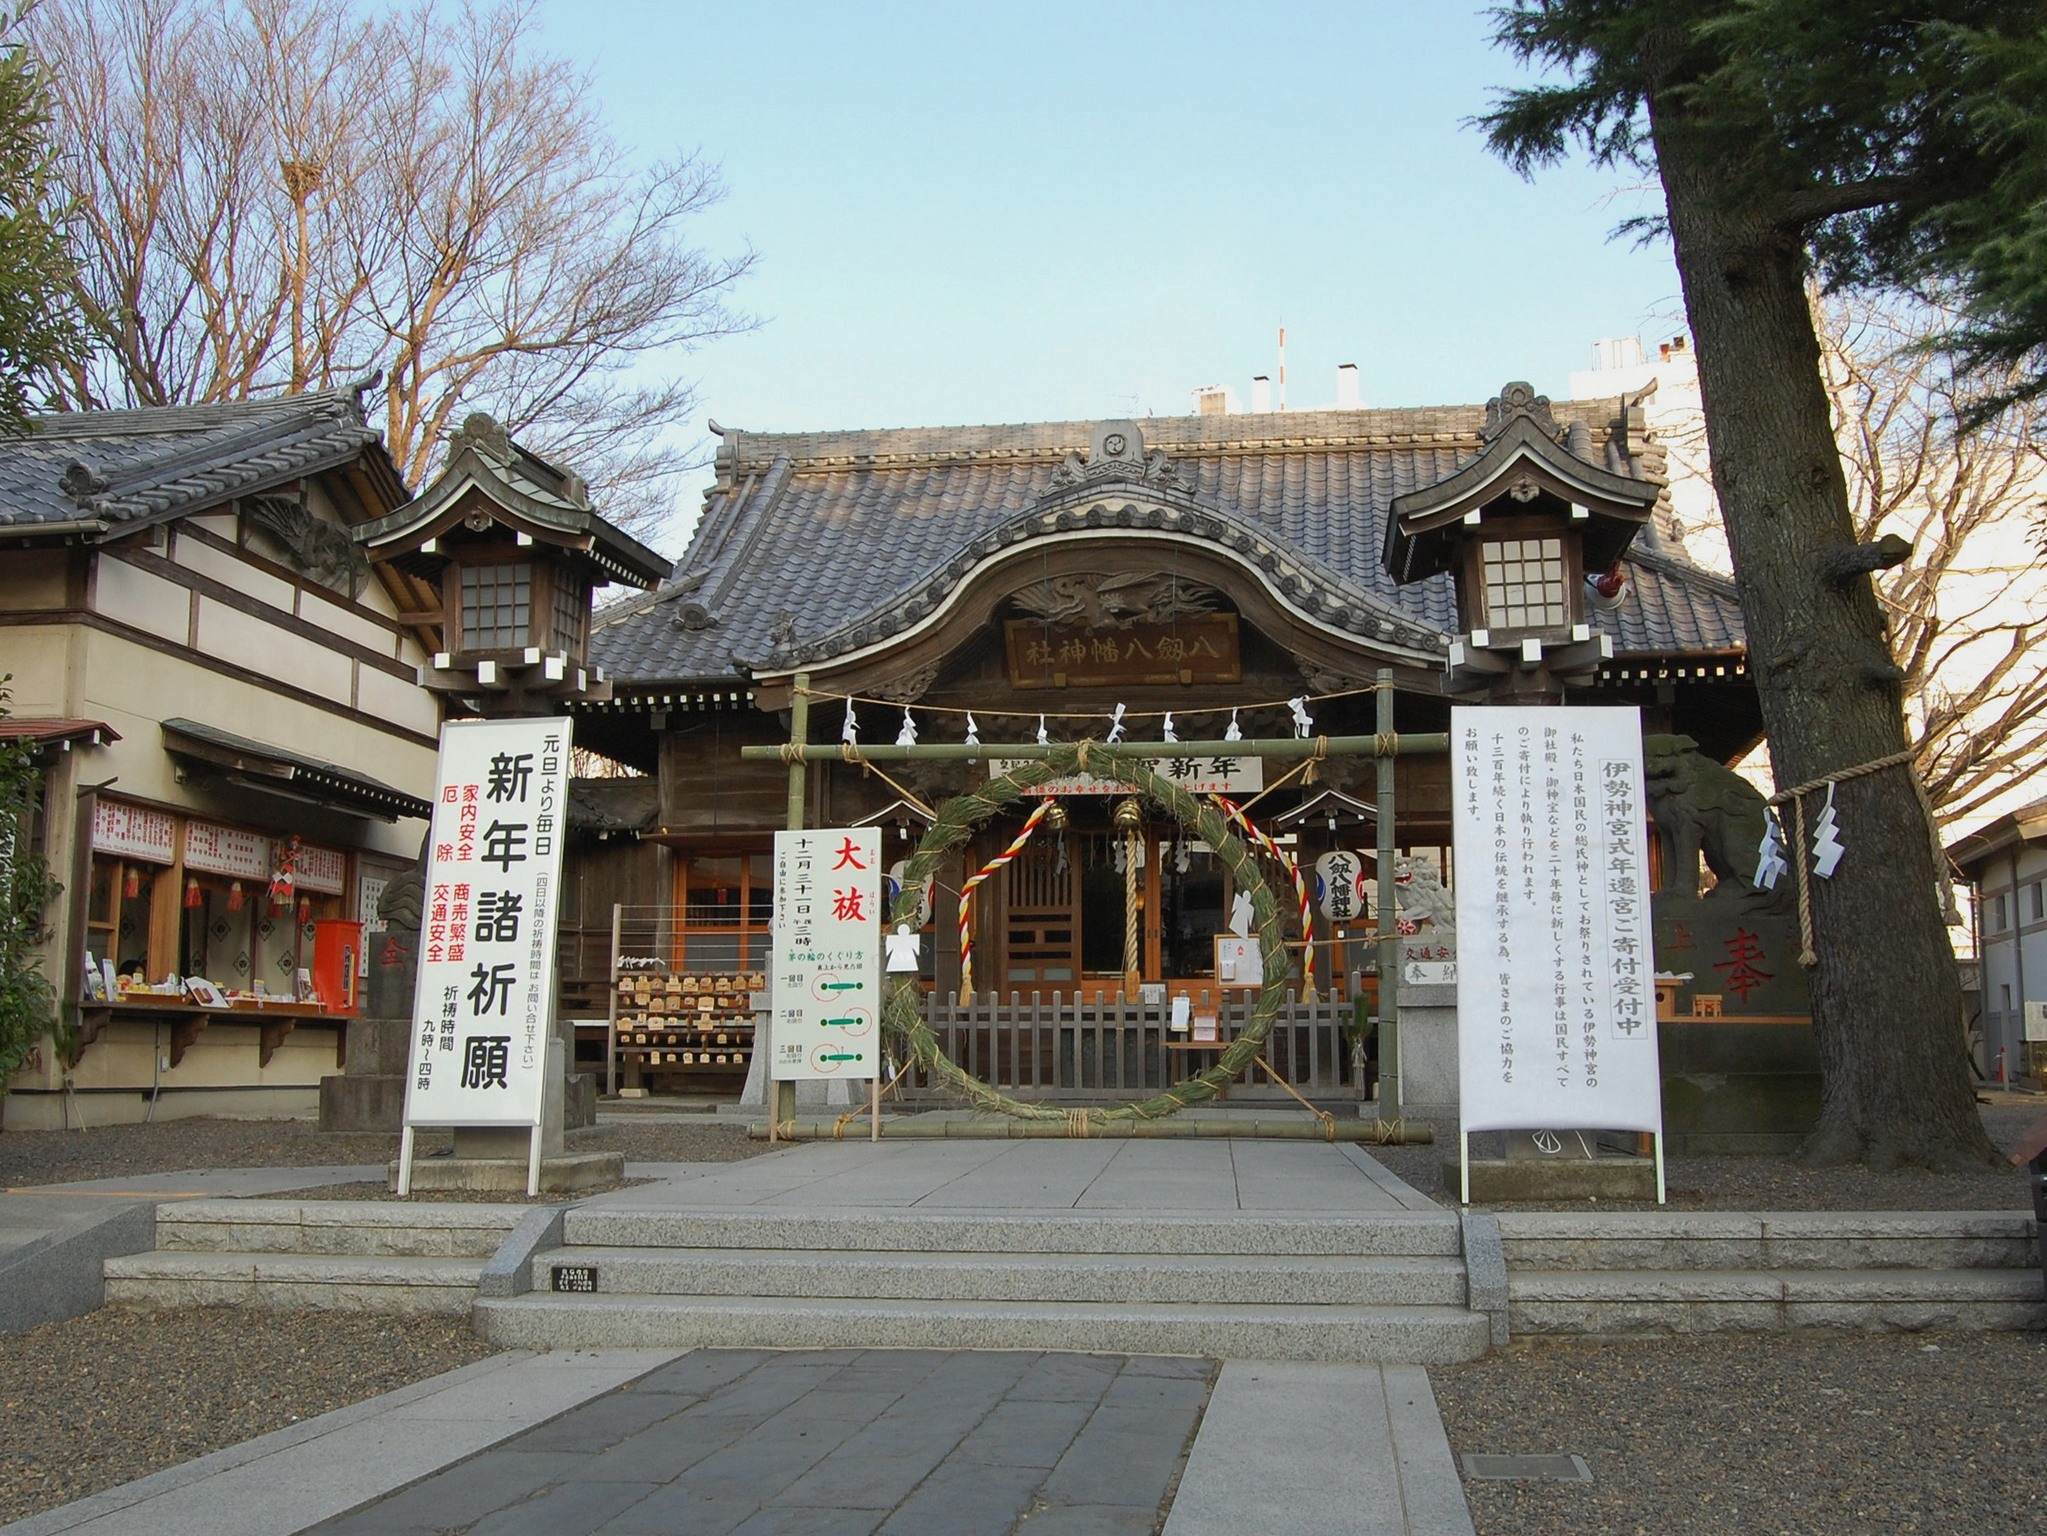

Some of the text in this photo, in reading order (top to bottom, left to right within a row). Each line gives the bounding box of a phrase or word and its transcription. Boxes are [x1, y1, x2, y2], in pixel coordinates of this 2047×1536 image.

[436, 785, 459, 862] 厄除
[457, 784, 479, 861] 家内安全
[535, 734, 560, 856] 元旦より毎日
[831, 836, 868, 922] 大祓
[1602, 761, 1644, 1036] 伊勢神宮式年遷宮ご寄付受付中
[427, 884, 450, 963] 交通安全
[447, 883, 470, 962] 商売繁盛
[460, 751, 534, 1090] 新年諸祈願
[1405, 947, 1457, 960] 交通安
[439, 985, 459, 1052] 祈祷時間
